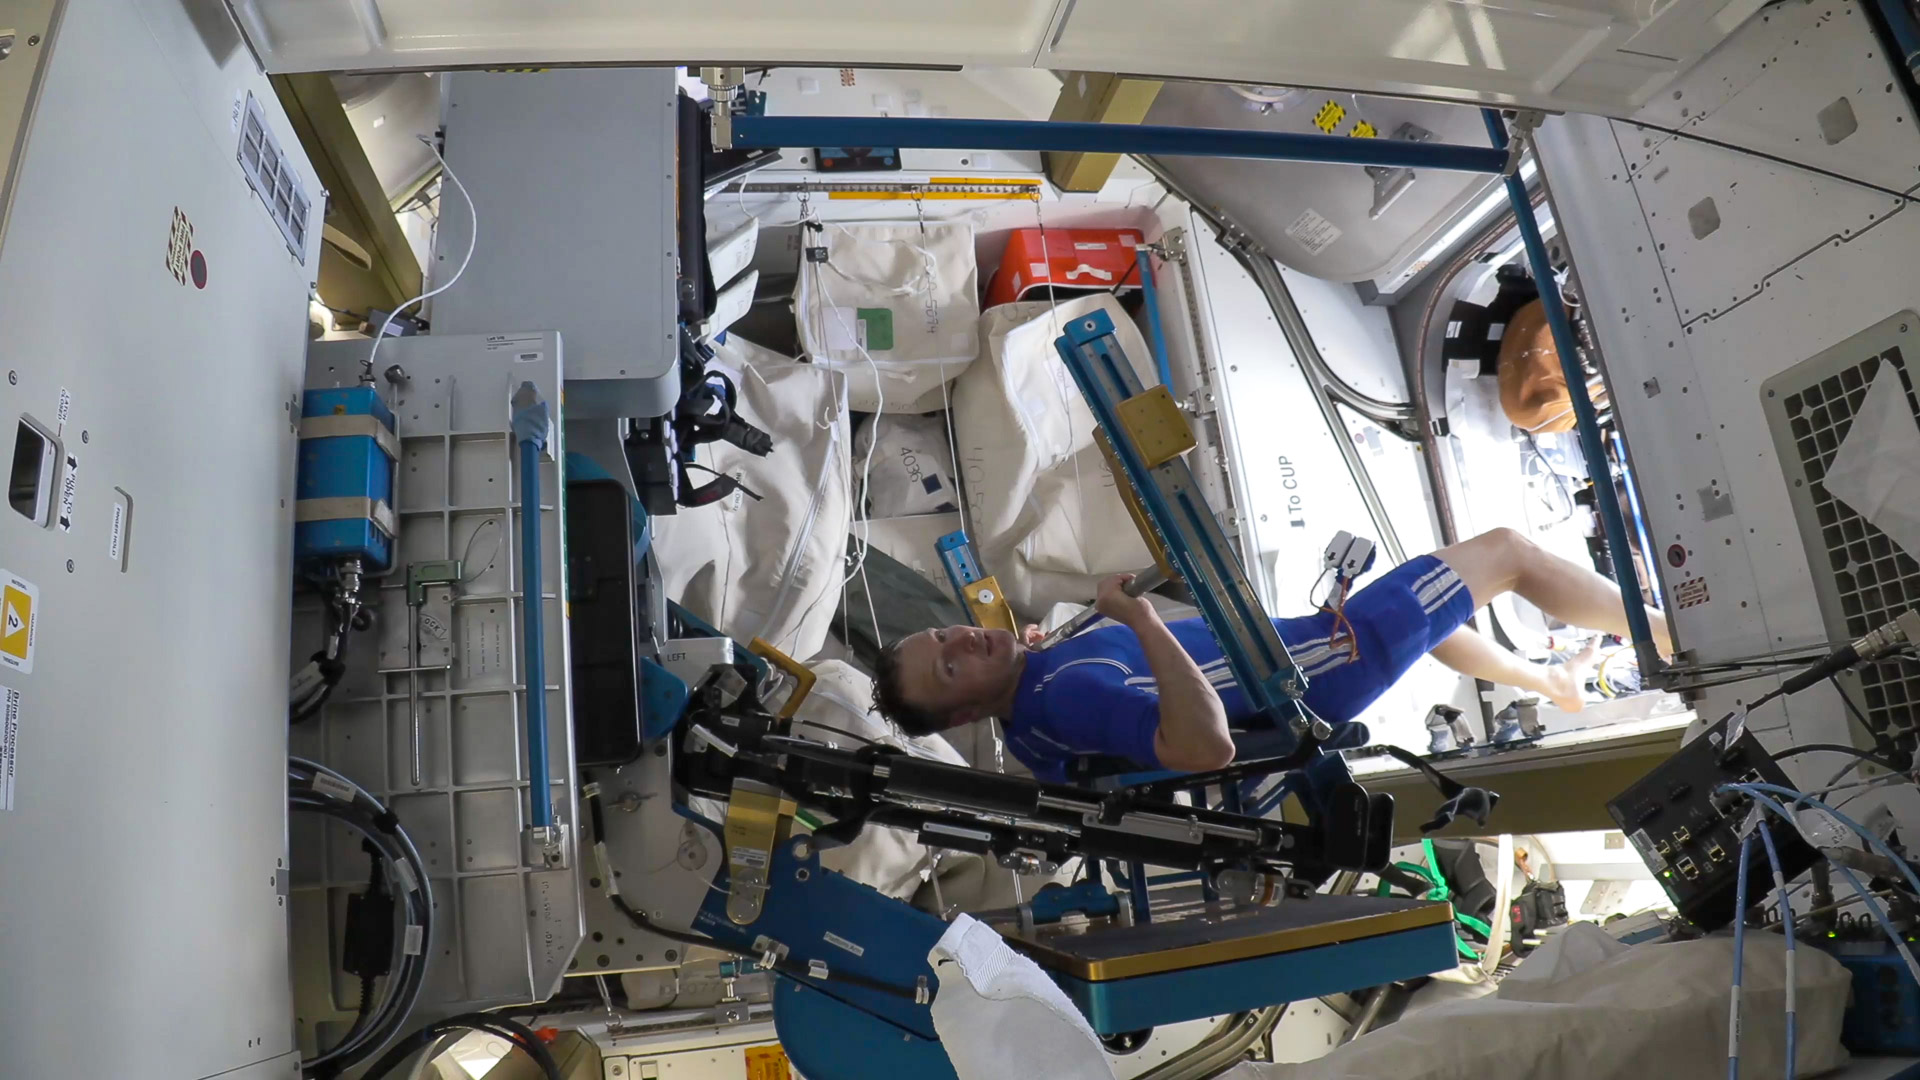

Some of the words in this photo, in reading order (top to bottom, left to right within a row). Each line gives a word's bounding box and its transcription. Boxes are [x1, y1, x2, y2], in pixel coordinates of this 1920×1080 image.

[57, 388, 67, 421] CLOSED
[62, 394, 70, 421] LATCH
[900, 446, 924, 484] 4036
[1278, 455, 1298, 490] CUP
[62, 477, 72, 506] OPEN
[68, 473, 77, 498] PULL
[65, 501, 74, 514] TO
[1287, 494, 1303, 515] To
[8, 613, 19, 629] 2
[424, 617, 441, 633] OCK
[666, 652, 686, 662] LEFT
[12, 691, 20, 720] Brine
[8, 722, 18, 778] Processor
